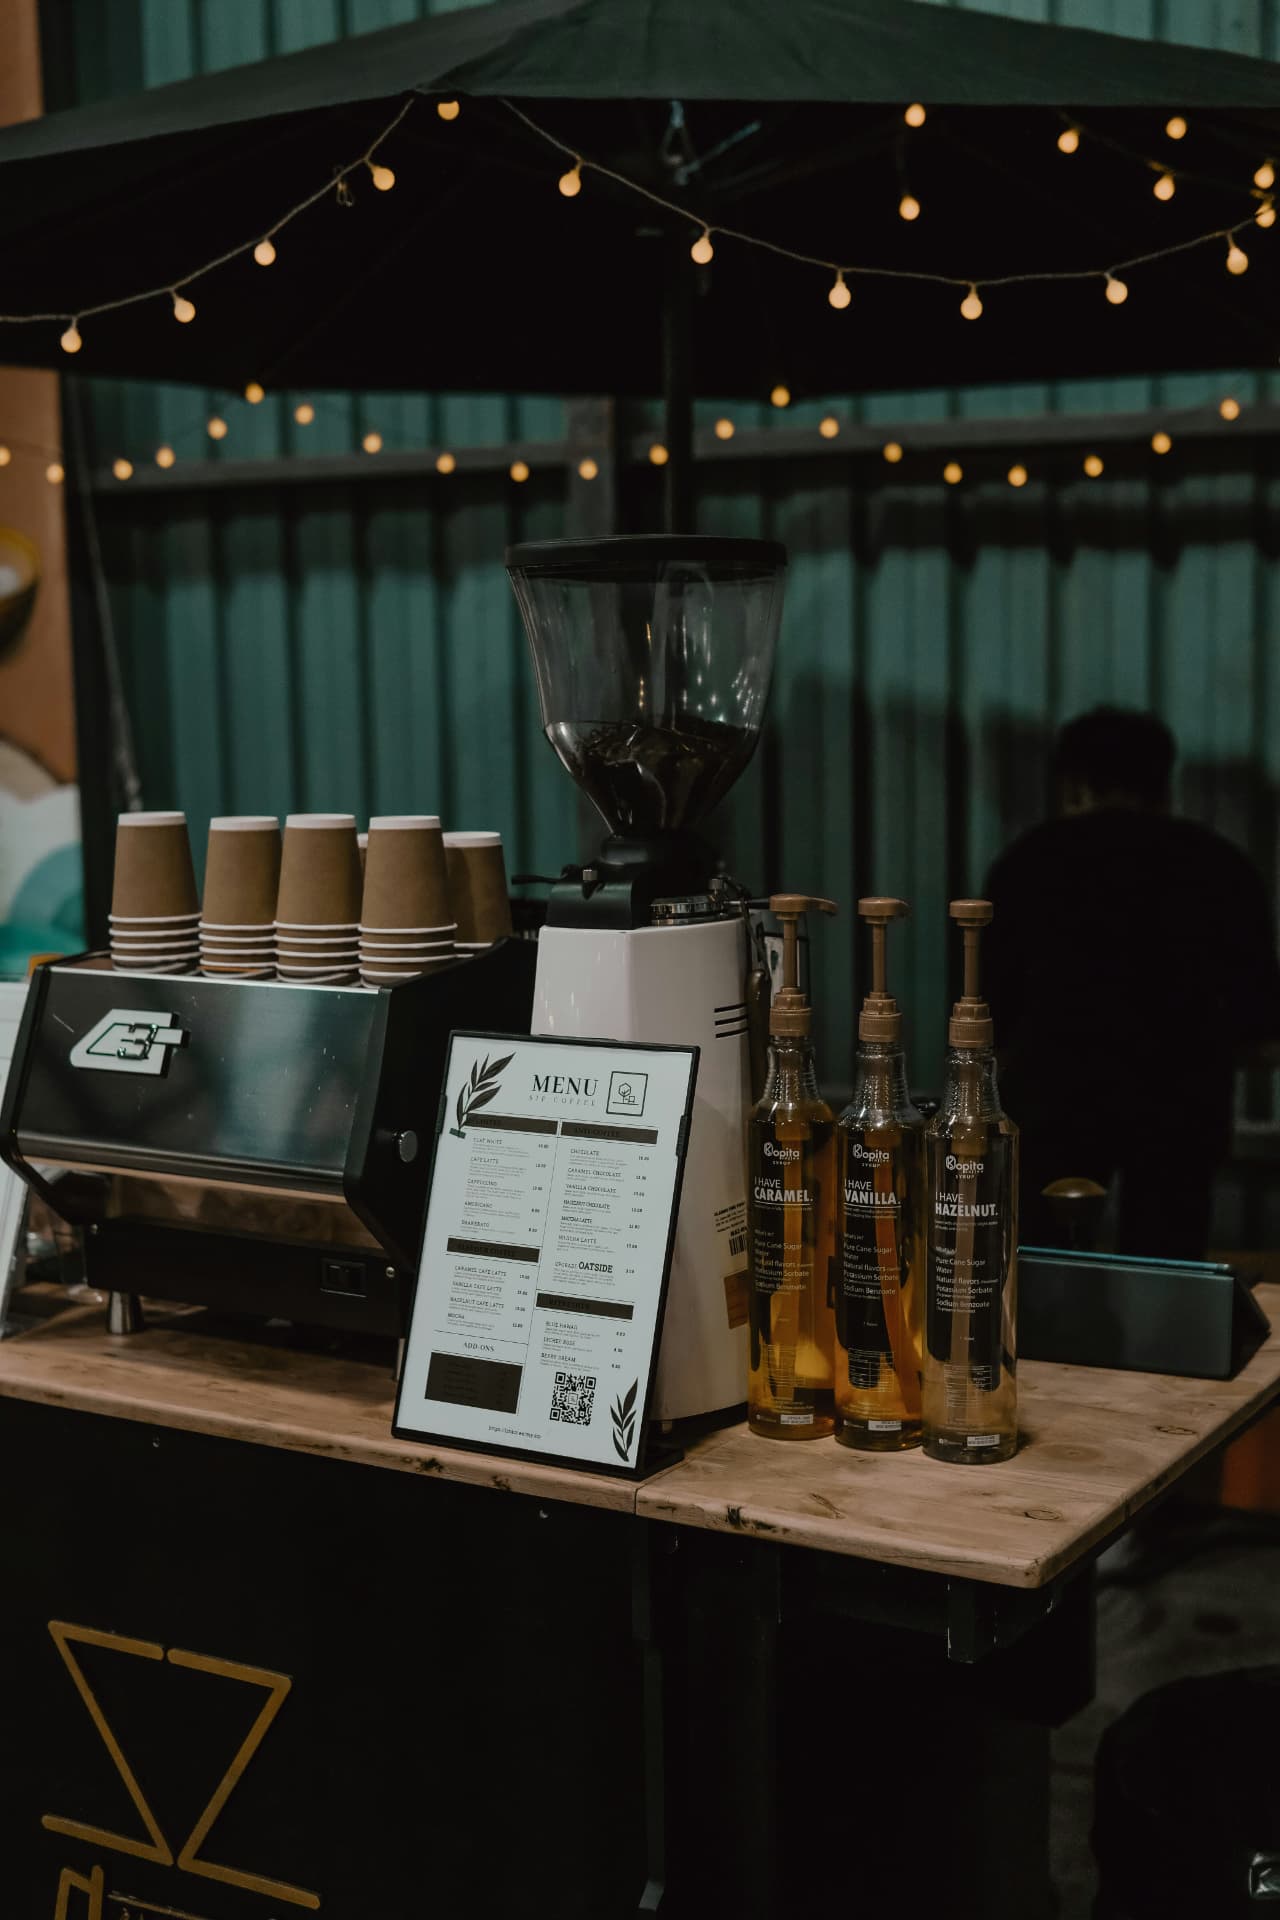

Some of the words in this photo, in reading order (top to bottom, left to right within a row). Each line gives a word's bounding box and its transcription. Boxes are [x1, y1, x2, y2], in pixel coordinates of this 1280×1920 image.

[532, 1074, 598, 1096] MENU
[763, 1142, 800, 1158] Kopita
[852, 1144, 890, 1160] Kopita
[945, 1155, 984, 1172] Kopita
[758, 1177, 781, 1188] HAVE
[848, 1179, 872, 1191] HAVE
[754, 1186, 814, 1202] CARAMEL.
[844, 1188, 901, 1204] VANILLA.
[940, 1192, 965, 1203] HAVE
[935, 1202, 998, 1216] HAZELNUT.
[856, 1244, 872, 1253] Cane
[874, 1246, 892, 1254] Sugar
[844, 1260, 864, 1270] Natural
[864, 1264, 886, 1272] flavors
[936, 1256, 949, 1264] Pure
[967, 1258, 986, 1267] Sugar
[578, 1262, 613, 1274] OATSIDE
[936, 1266, 952, 1274] Water
[844, 1269, 872, 1280] Potassium
[874, 1273, 898, 1281] Sorbate
[936, 1275, 956, 1284] Natural
[958, 1277, 980, 1285] flavors
[844, 1282, 864, 1292] Sodium
[936, 1284, 967, 1294] Potassium
[968, 1286, 993, 1294] Sorbate
[936, 1298, 959, 1307] Sodium
[464, 1342, 495, 1352] ADD-ONS
